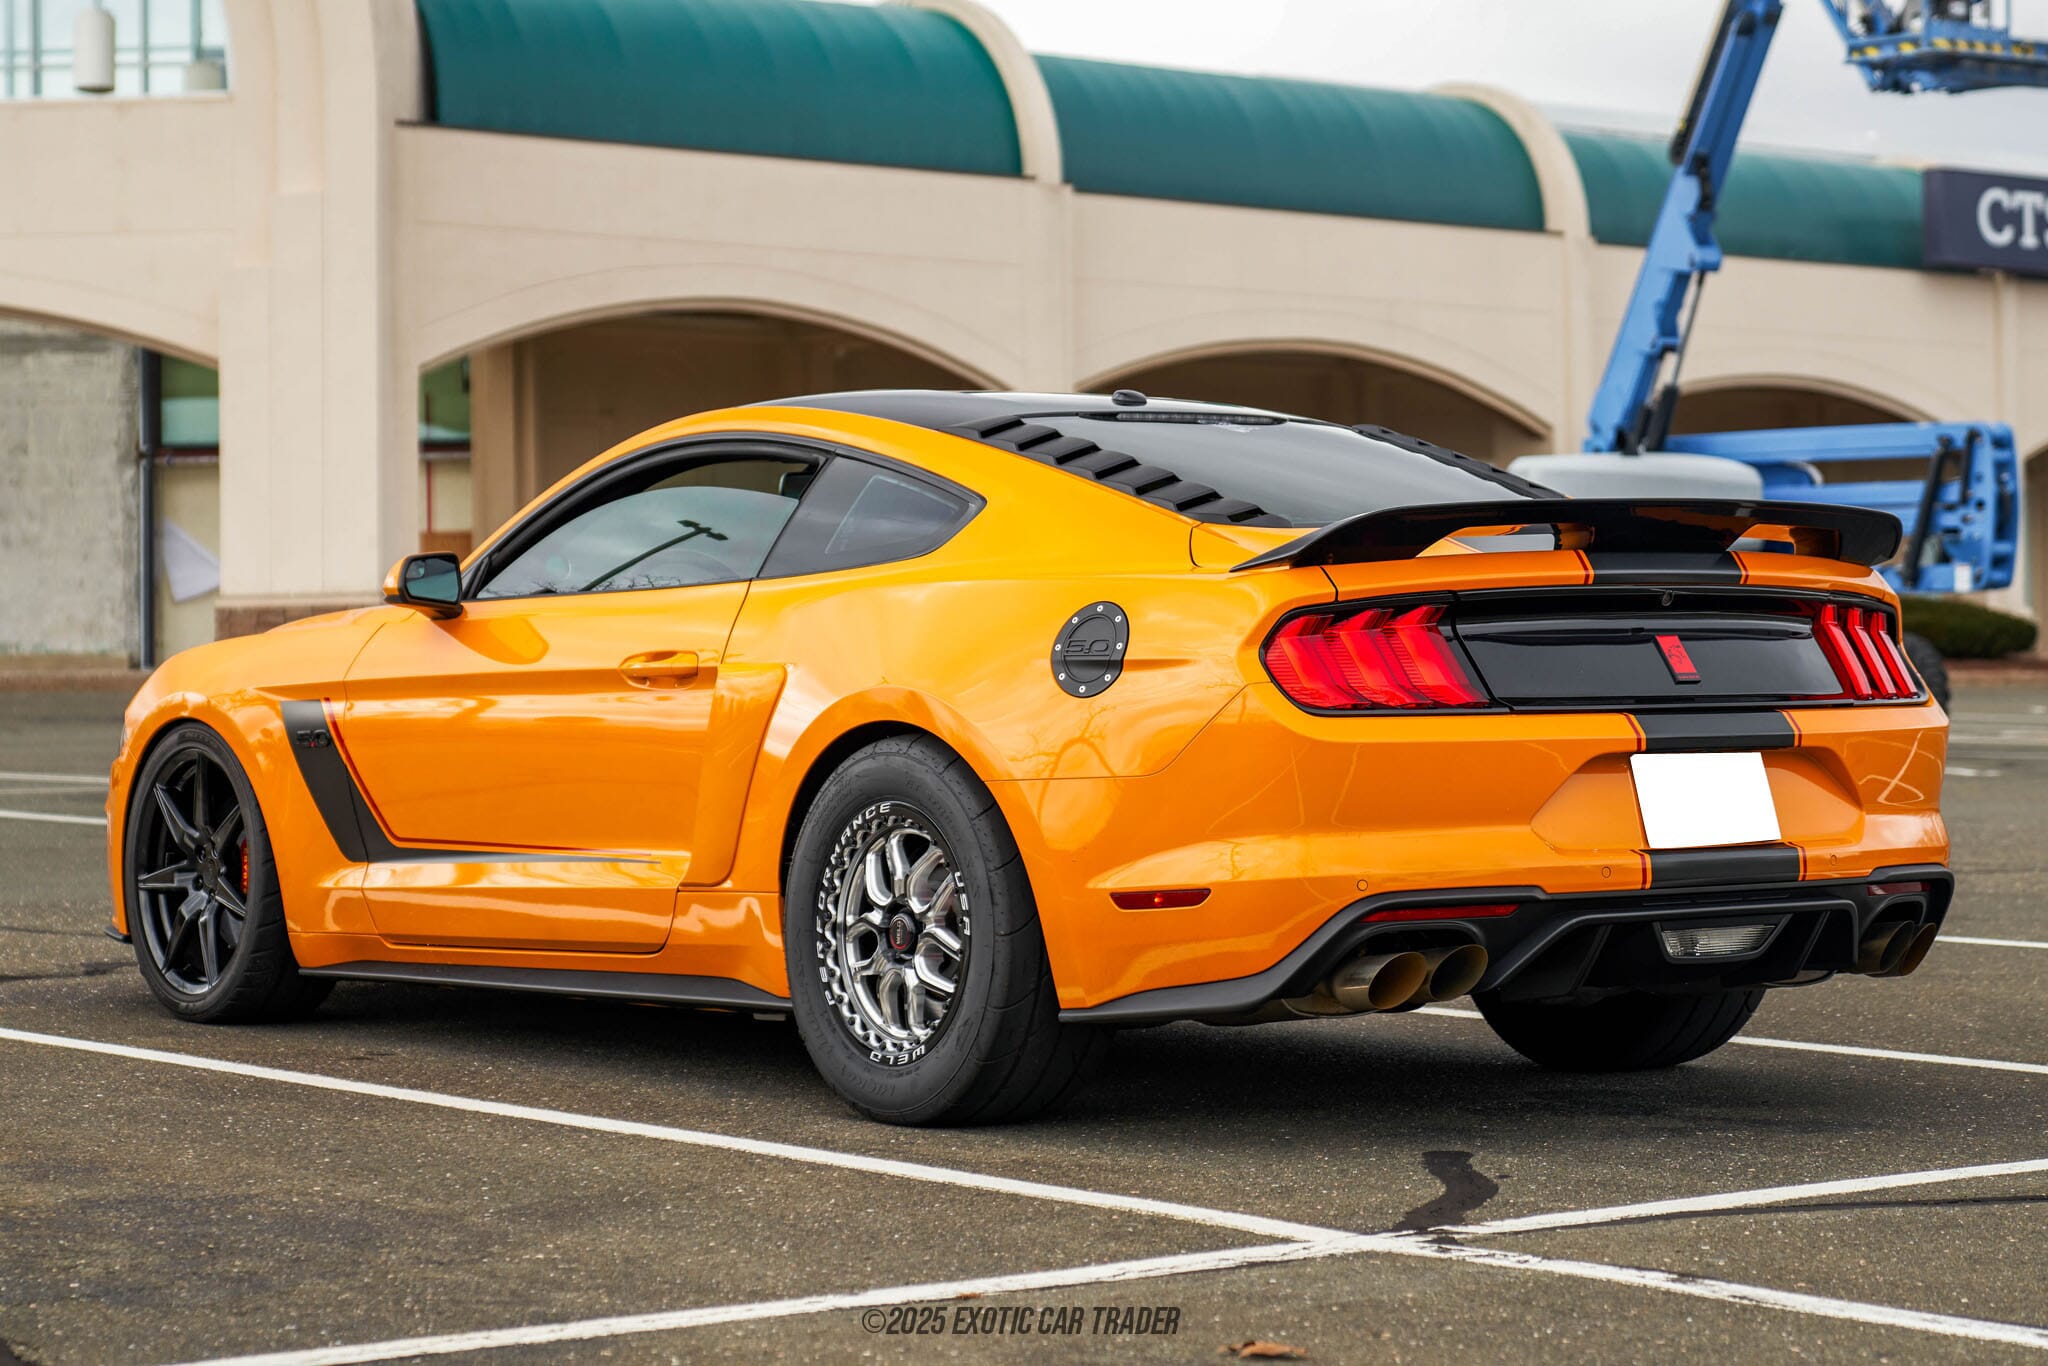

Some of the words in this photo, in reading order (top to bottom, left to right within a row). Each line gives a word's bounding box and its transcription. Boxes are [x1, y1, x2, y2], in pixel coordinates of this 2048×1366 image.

[1976, 186, 2048, 249] CT
[816, 802, 891, 1006] PERFORMANCE
[954, 871, 971, 936] USA
[869, 1045, 926, 1065] WELD
